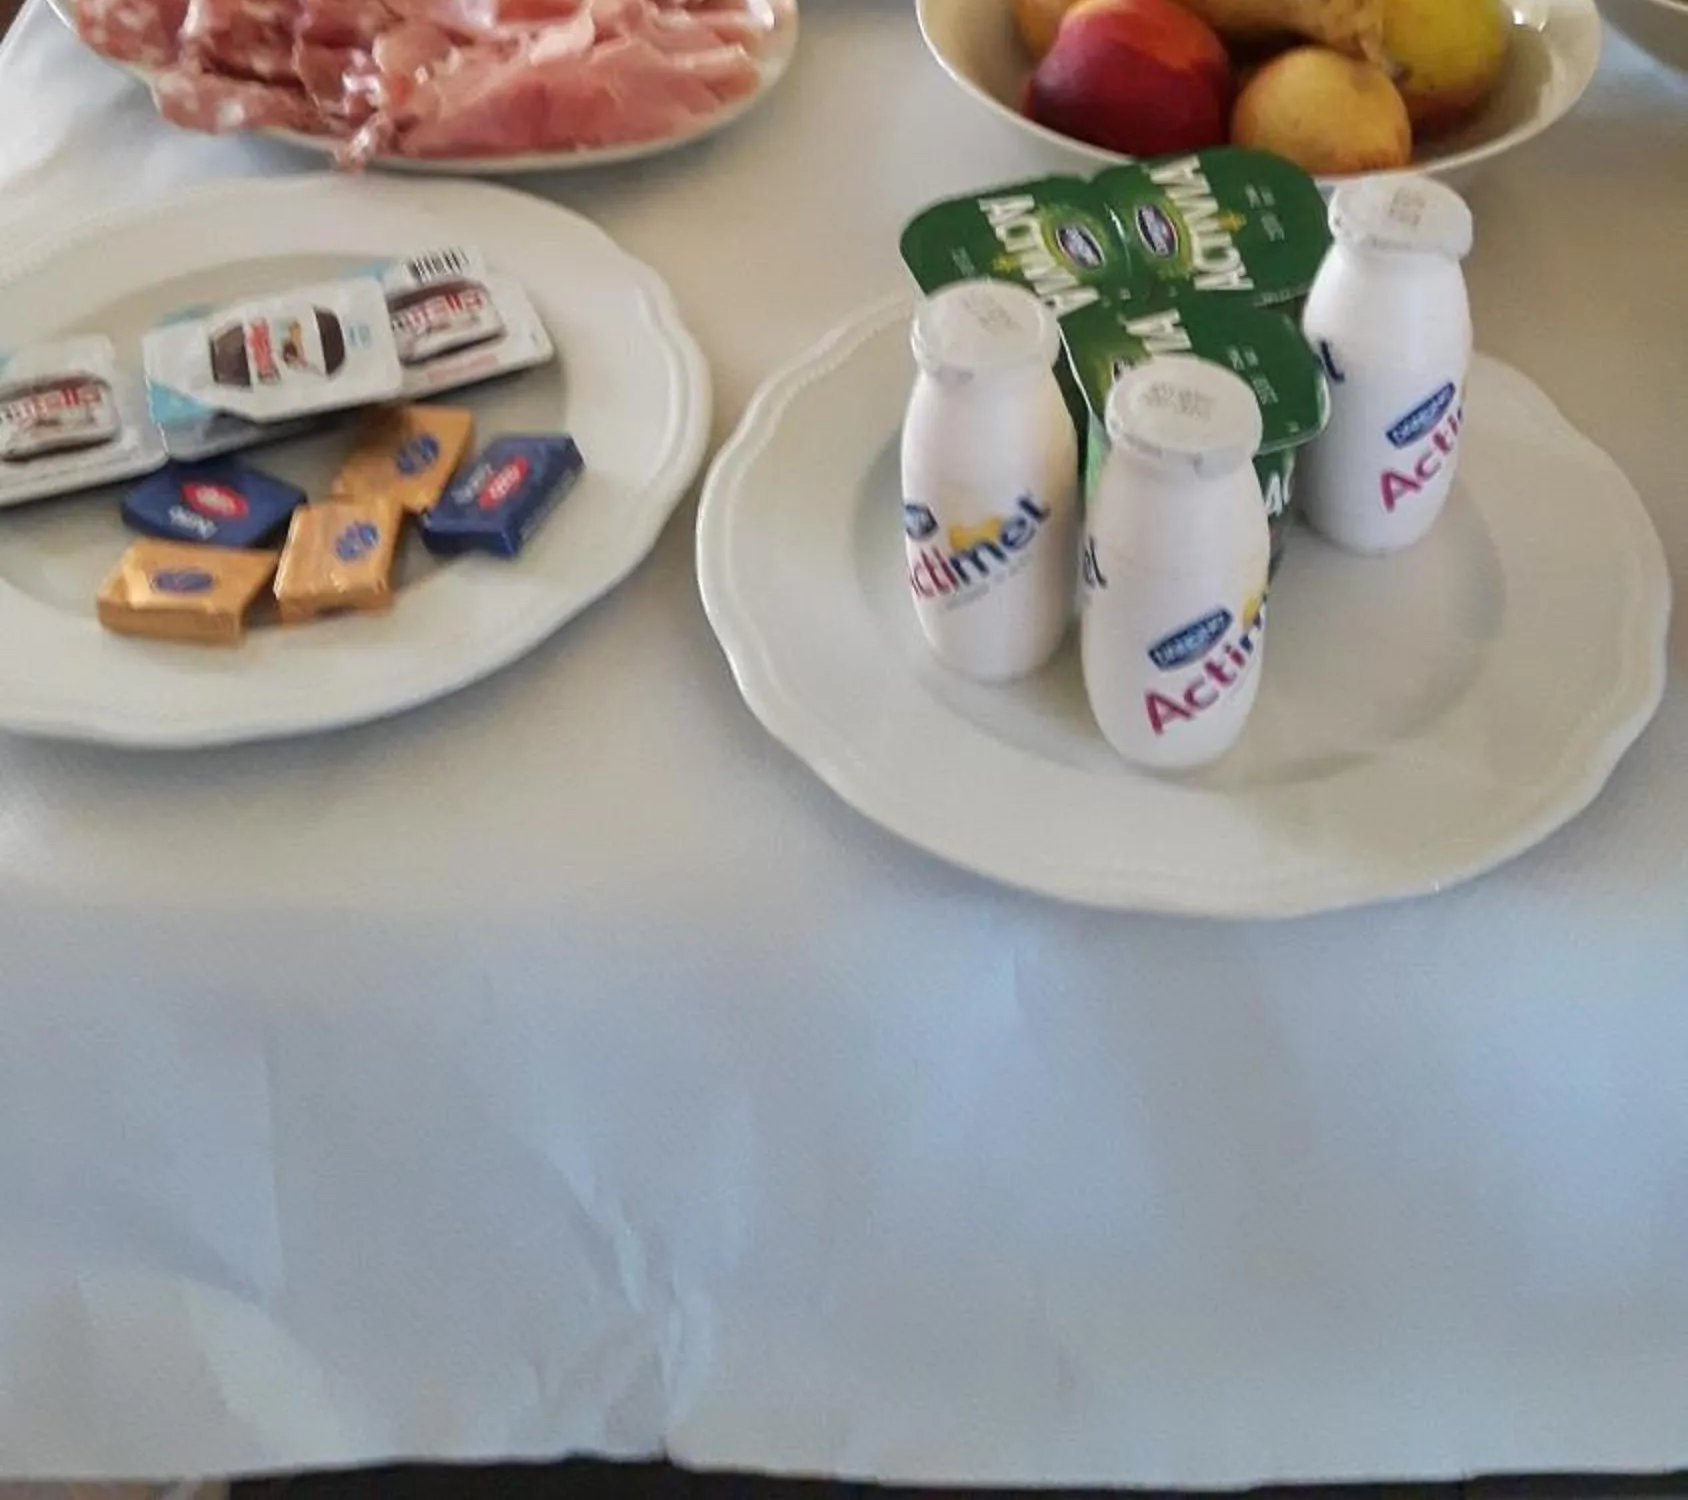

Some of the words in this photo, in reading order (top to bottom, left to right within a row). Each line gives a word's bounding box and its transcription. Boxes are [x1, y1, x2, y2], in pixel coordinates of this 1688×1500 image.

[978, 195, 1098, 315] ACTIVIA
[1151, 156, 1253, 290] ACTIVIA
[1379, 406, 1464, 513] Acti
[909, 493, 1052, 598] ctimel
